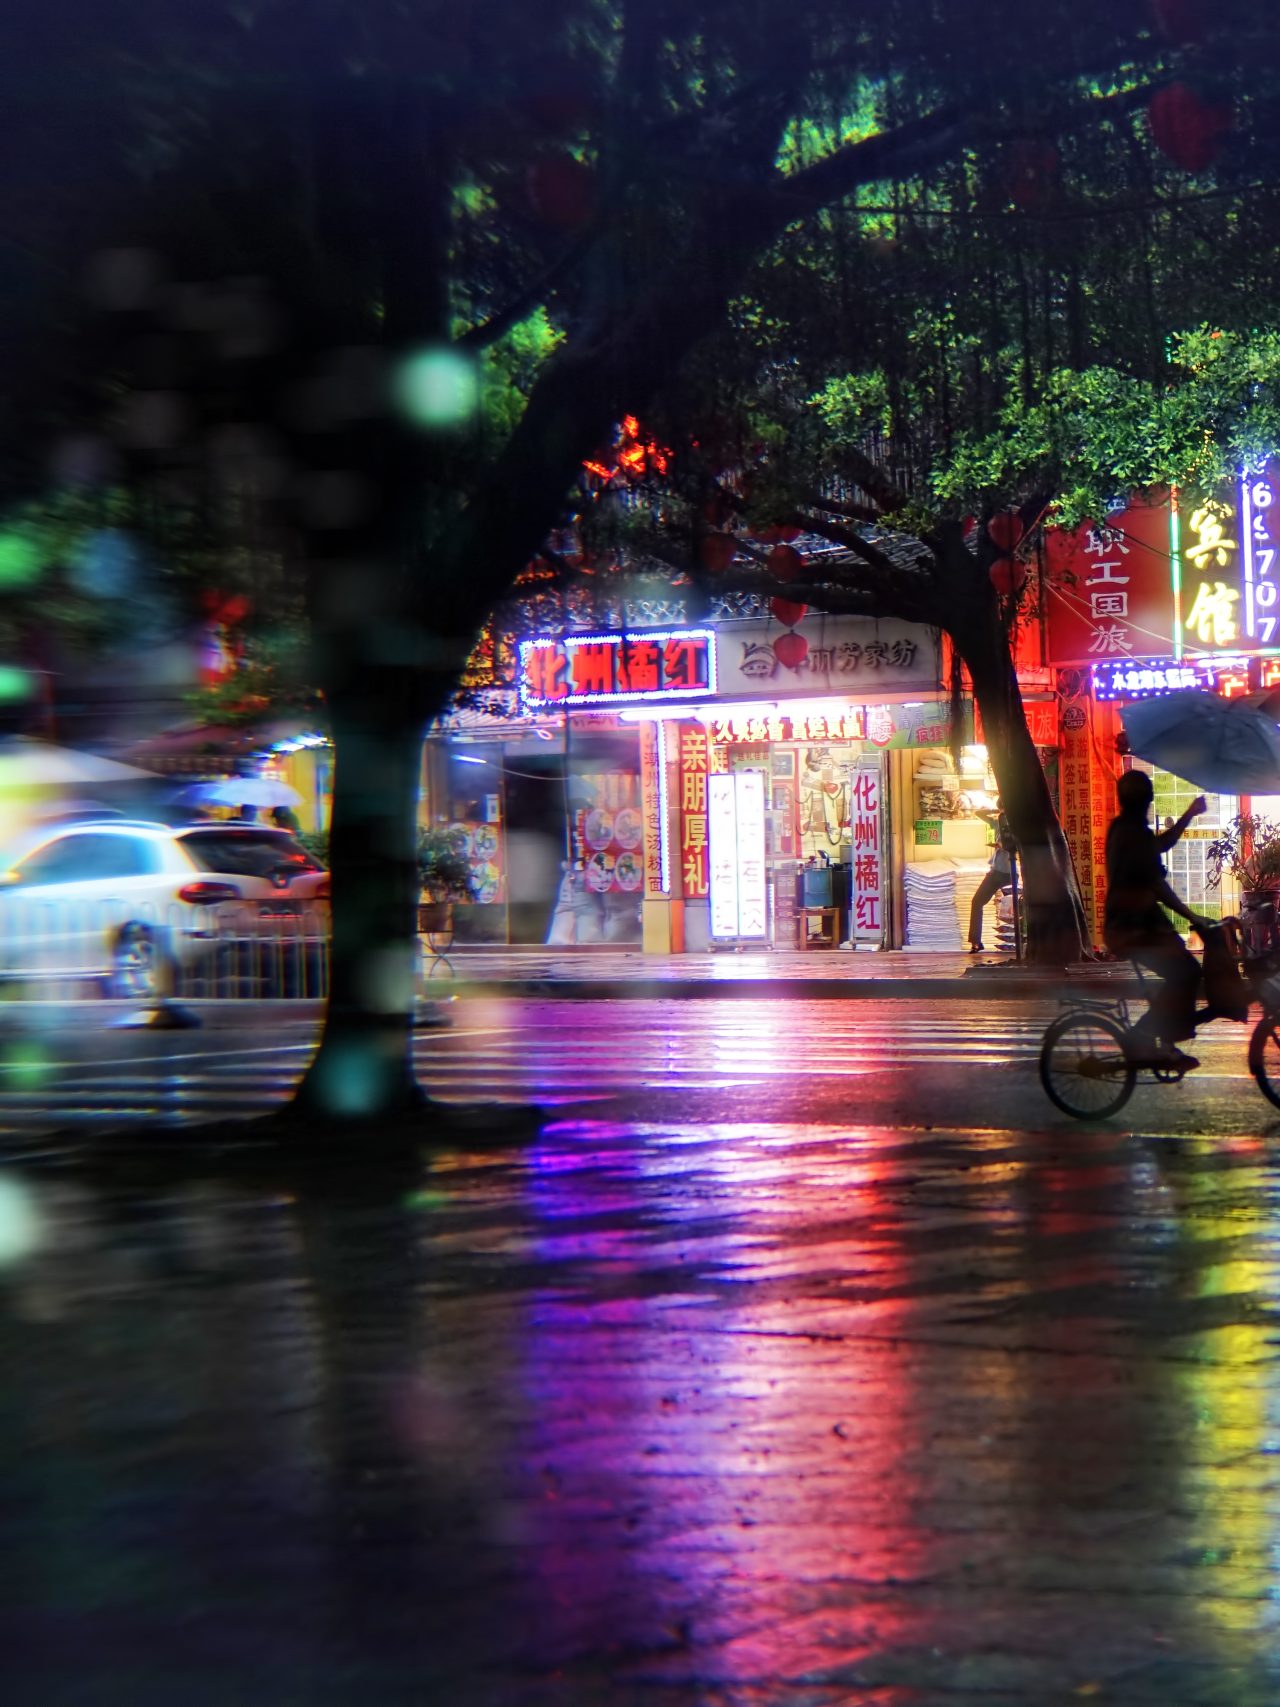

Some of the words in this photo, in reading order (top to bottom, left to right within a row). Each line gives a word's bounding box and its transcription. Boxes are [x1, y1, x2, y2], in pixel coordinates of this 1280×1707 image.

[1084, 528, 1134, 653] 职工国旅
[526, 639, 706, 701] 化州橘红
[788, 639, 918, 677] 丽芳家纺
[683, 731, 709, 896] 亲朋厚礼
[853, 775, 881, 930] 化州橘红
